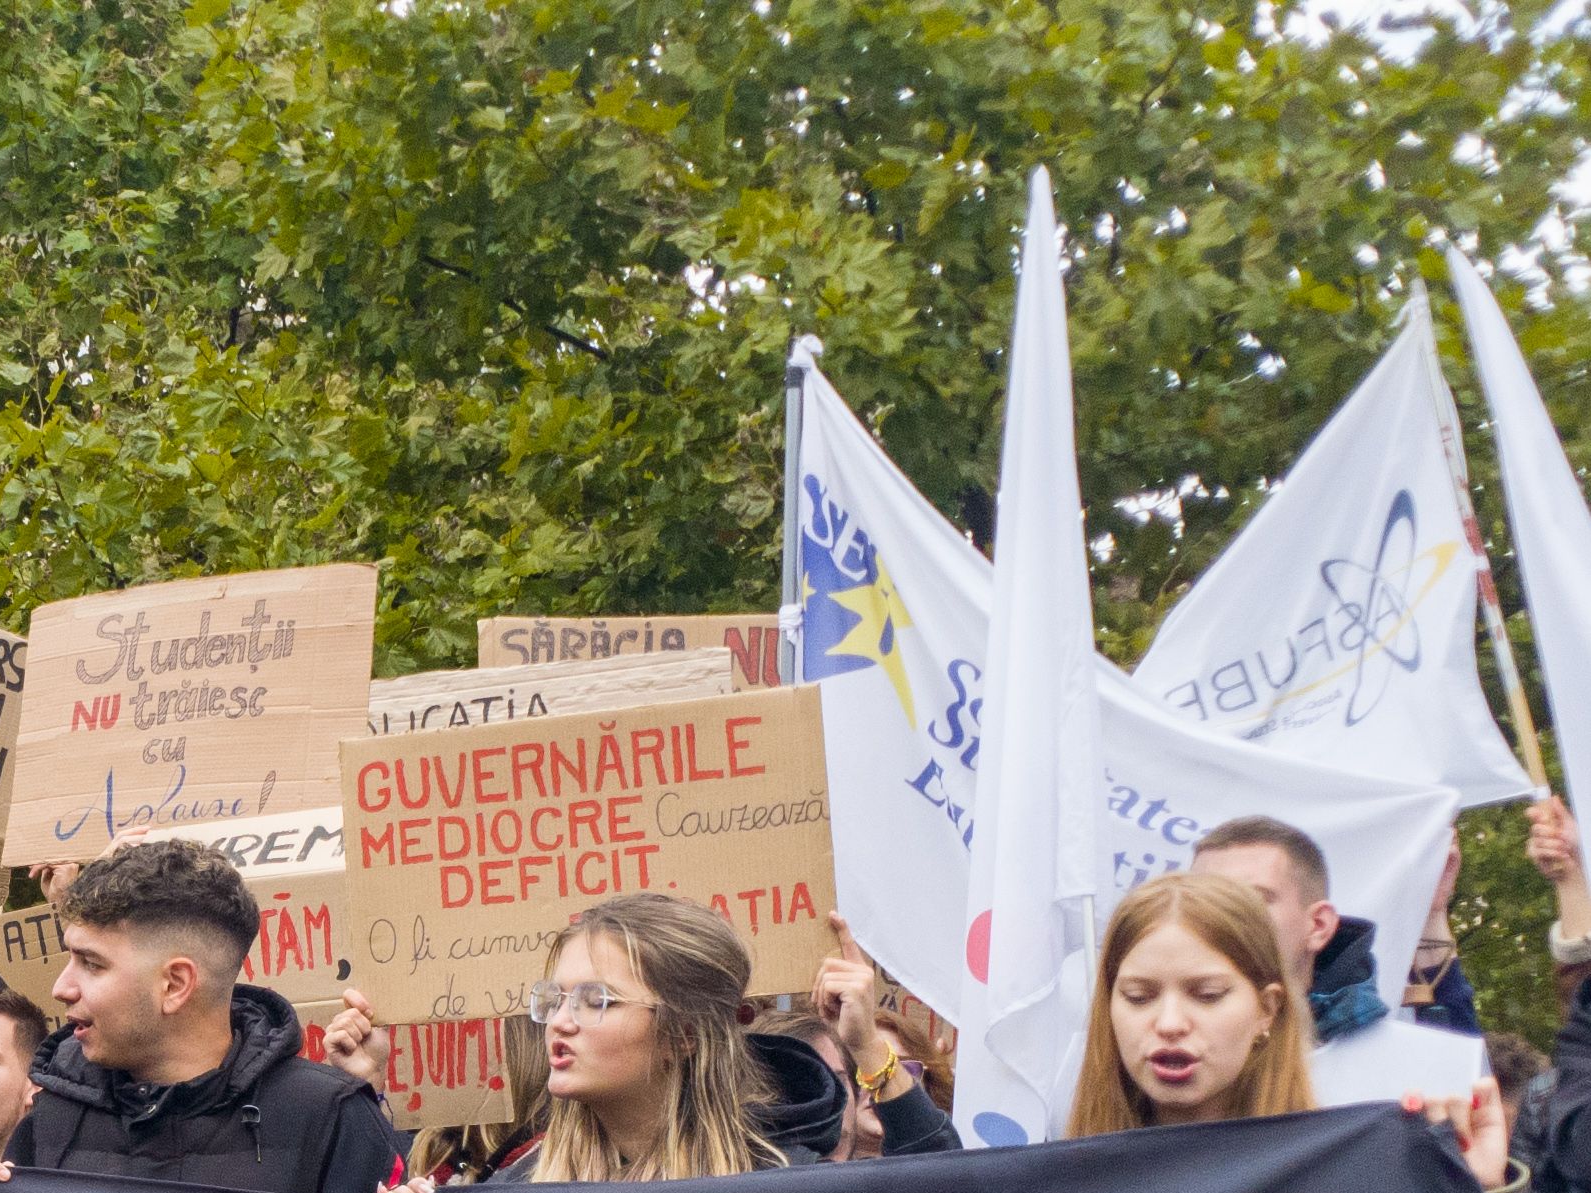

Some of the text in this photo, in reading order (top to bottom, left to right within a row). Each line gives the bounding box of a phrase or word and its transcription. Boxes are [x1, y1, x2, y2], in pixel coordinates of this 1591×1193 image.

[75, 599, 296, 685] Studenții
[71, 678, 268, 731] NU trăiesc
[142, 736, 187, 765] cu
[356, 716, 766, 814] GUVERNĂRILE
[359, 795, 646, 869] MEDIOCRE
[369, 918, 396, 963] O
[428, 973, 466, 1020] de
